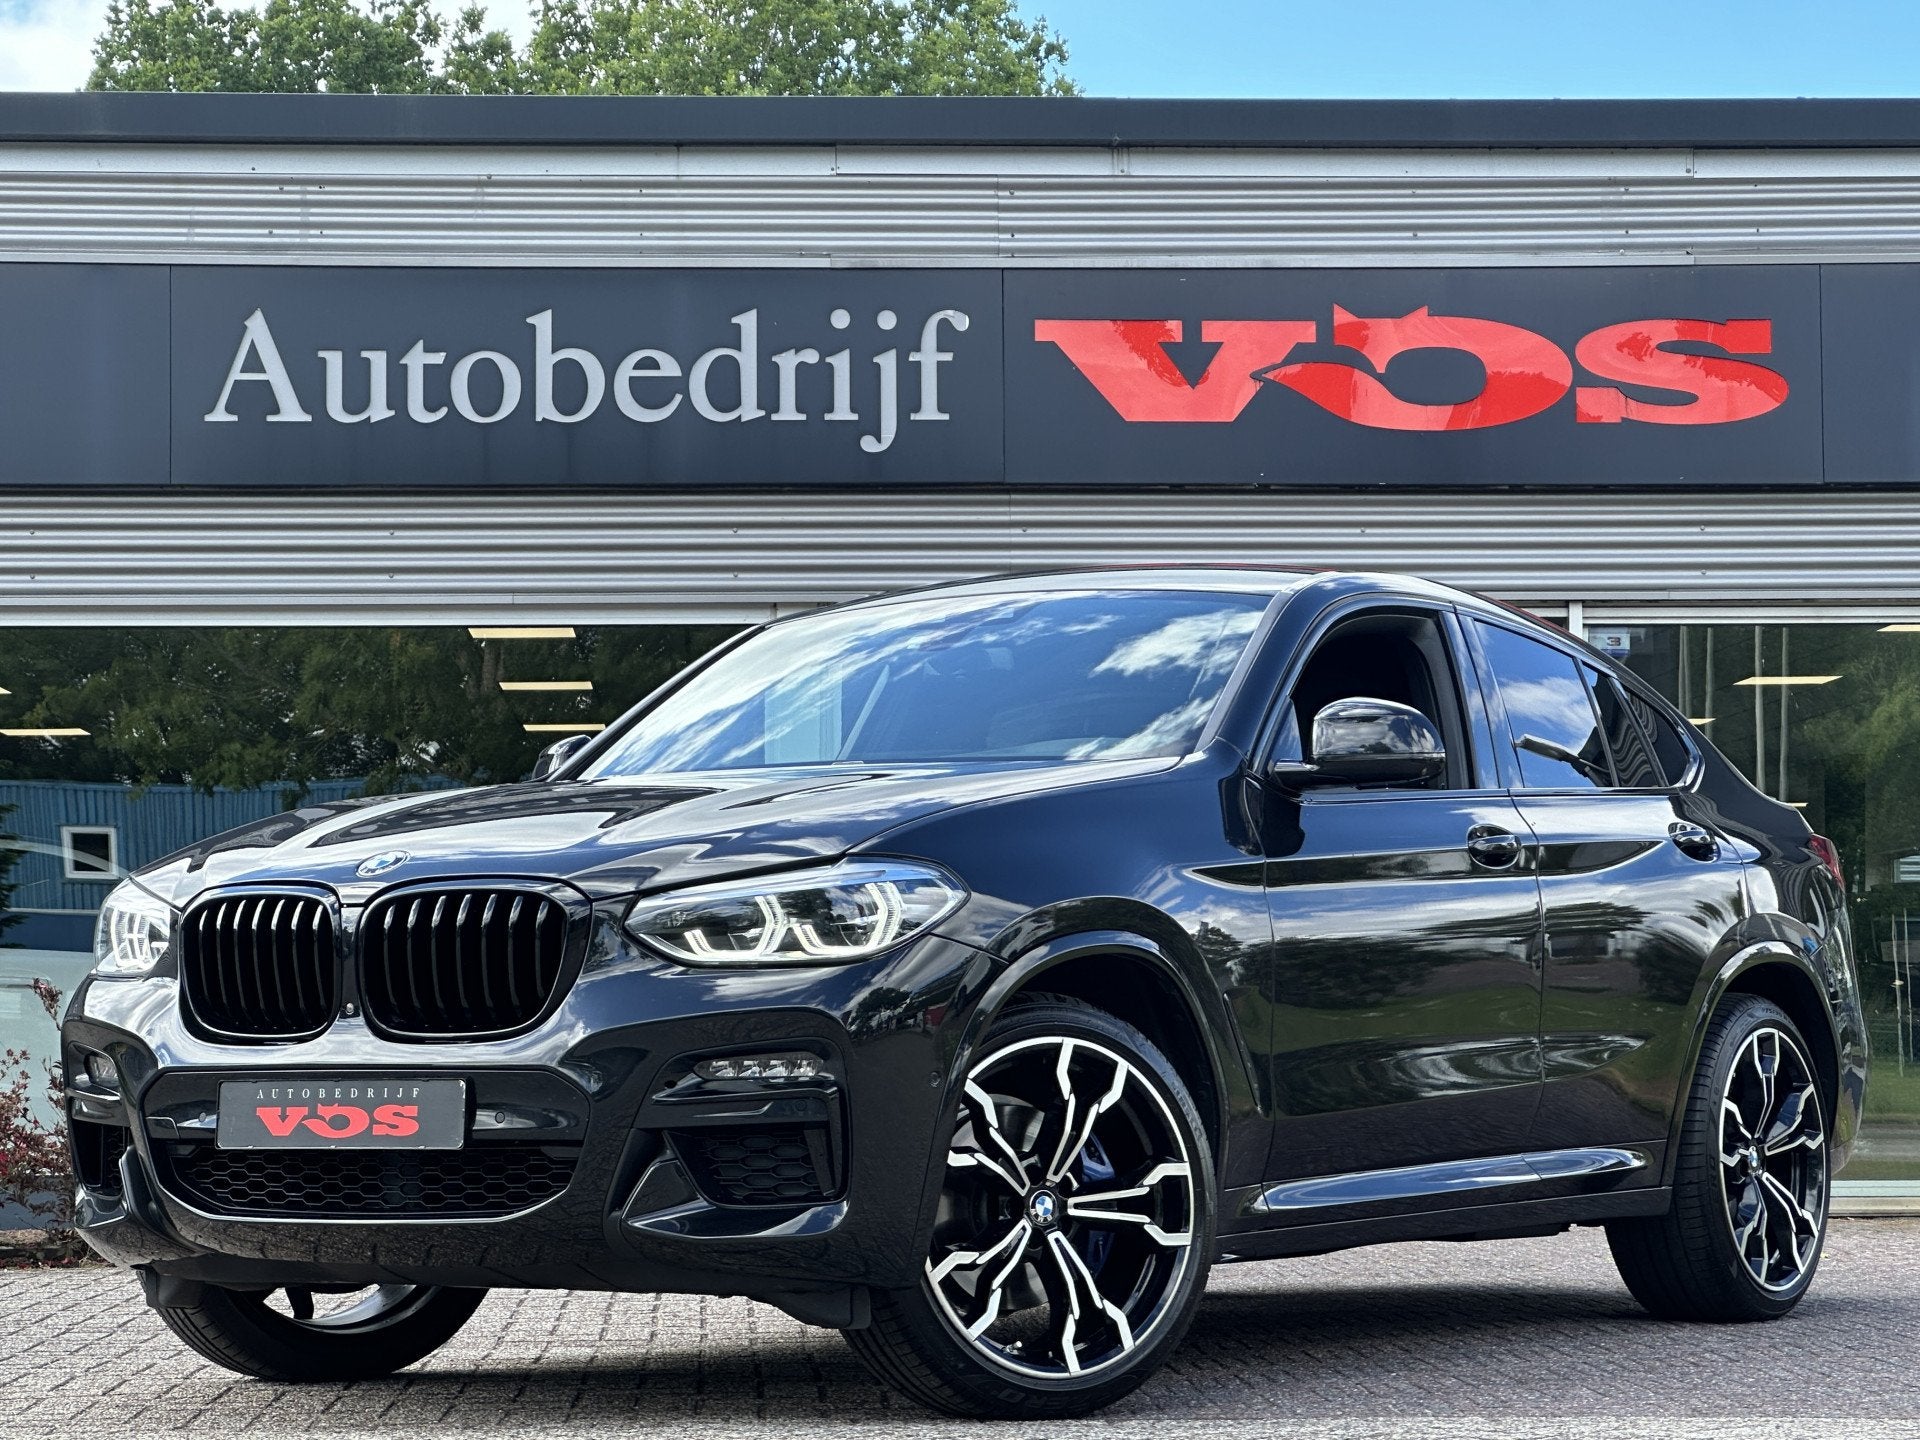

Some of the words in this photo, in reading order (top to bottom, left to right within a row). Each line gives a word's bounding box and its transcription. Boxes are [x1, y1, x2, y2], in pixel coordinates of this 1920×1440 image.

[203, 307, 970, 453] Autobedrijf
[1034, 303, 1789, 431] VOS
[256, 1087, 420, 1099] AUTOBEDRIJF
[256, 1103, 420, 1139] VOS
